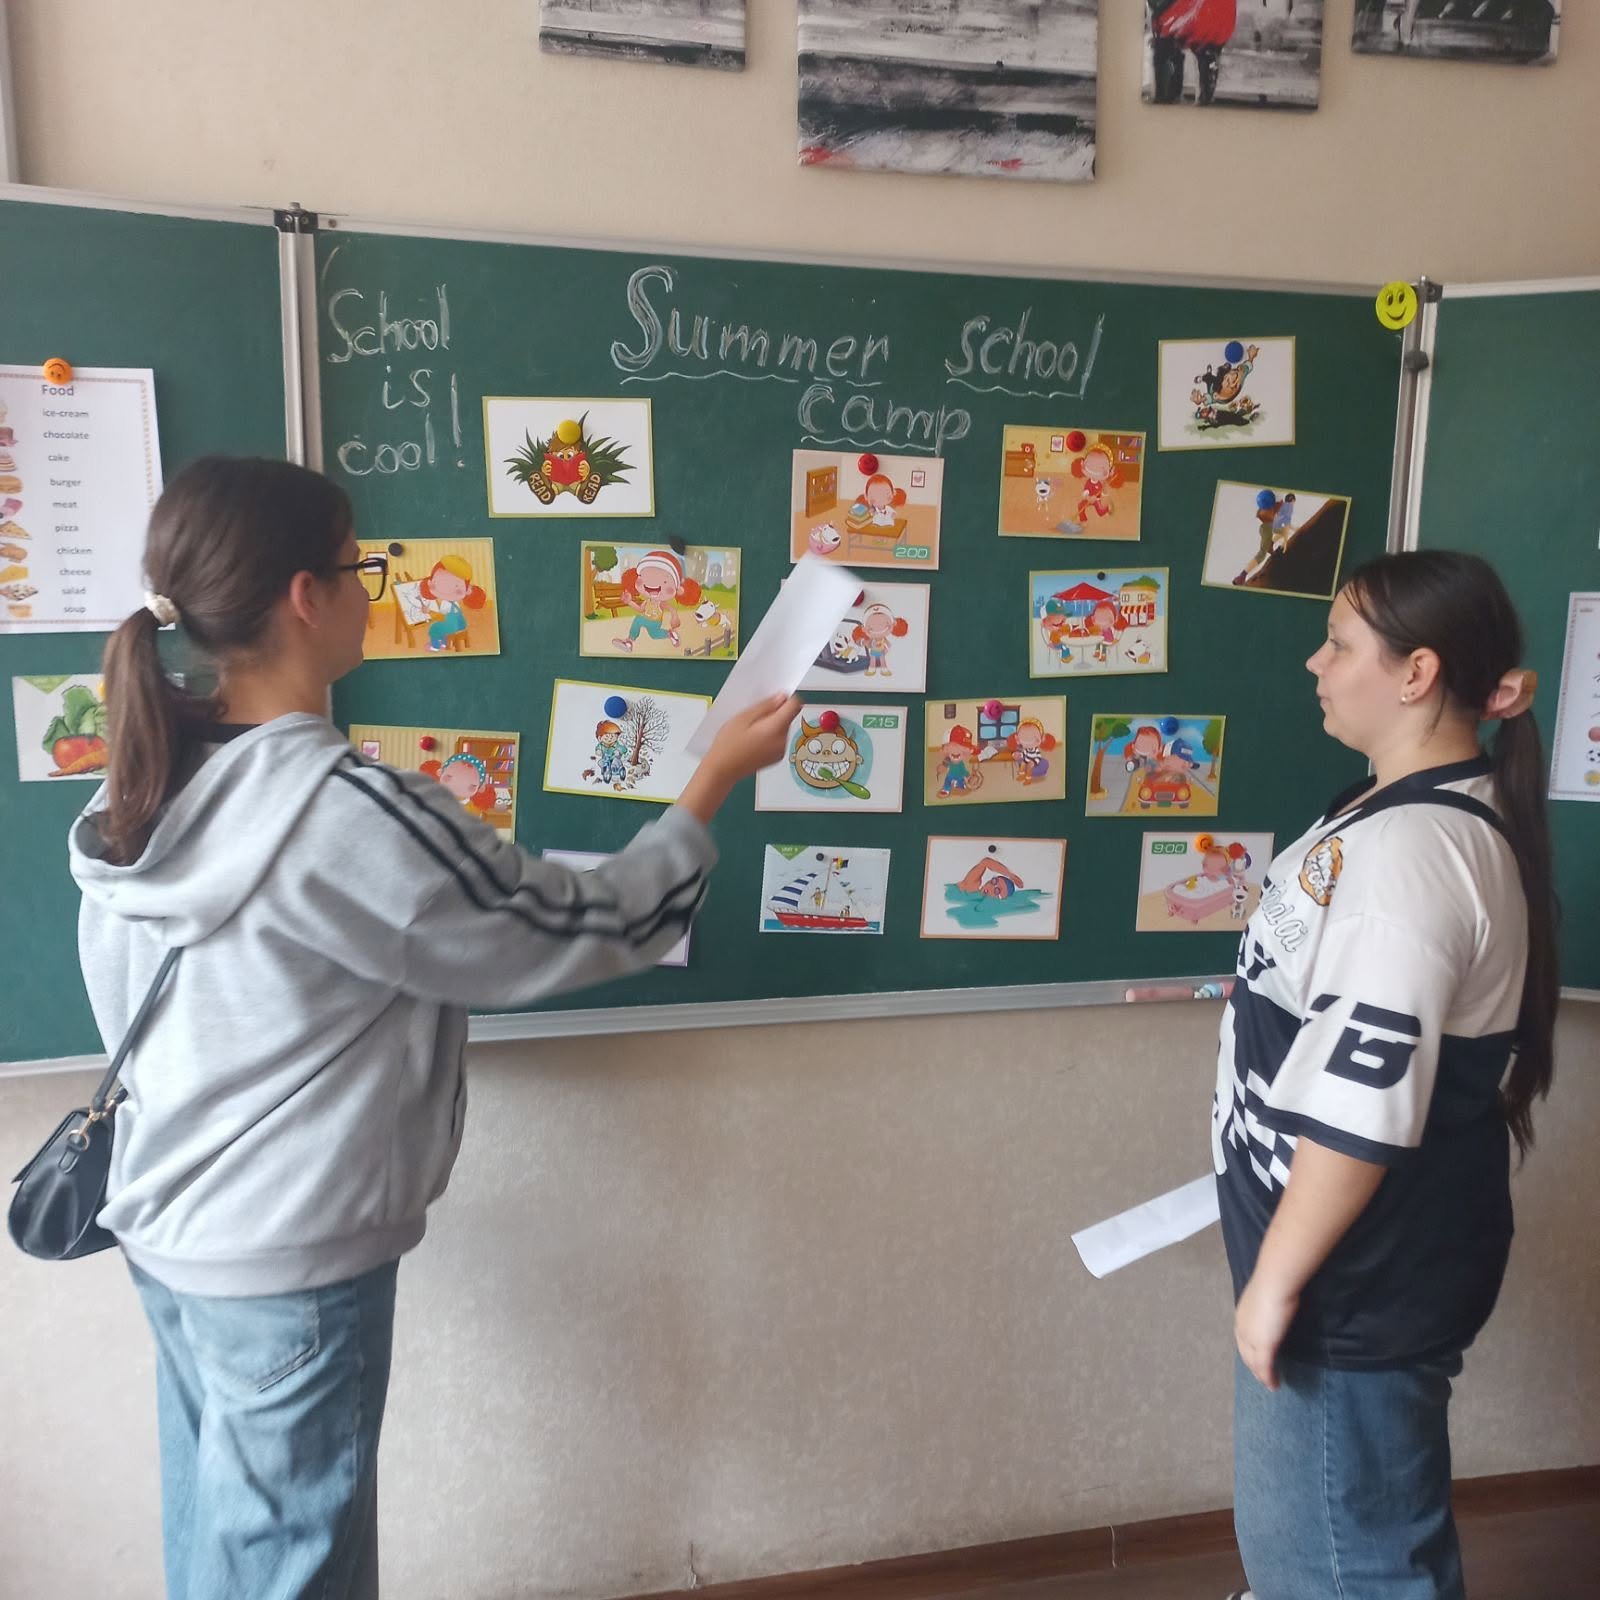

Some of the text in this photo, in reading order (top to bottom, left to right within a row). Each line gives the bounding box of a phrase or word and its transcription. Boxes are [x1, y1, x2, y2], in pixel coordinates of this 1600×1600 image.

[327, 283, 450, 363] School
[610, 264, 890, 378] Summer
[41, 384, 75, 396] Food
[382, 364, 434, 409] is
[41, 408, 90, 419] ice-cream
[42, 430, 90, 440] chocolate
[48, 453, 71, 462] cake
[50, 477, 82, 489] burger
[529, 472, 552, 502] READ
[582, 474, 601, 503] READ
[53, 501, 78, 510] meat
[55, 523, 79, 534] pizza
[56, 546, 93, 556] chicken
[59, 567, 92, 577] cheese
[62, 586, 87, 596] salad
[63, 605, 87, 615] soup
